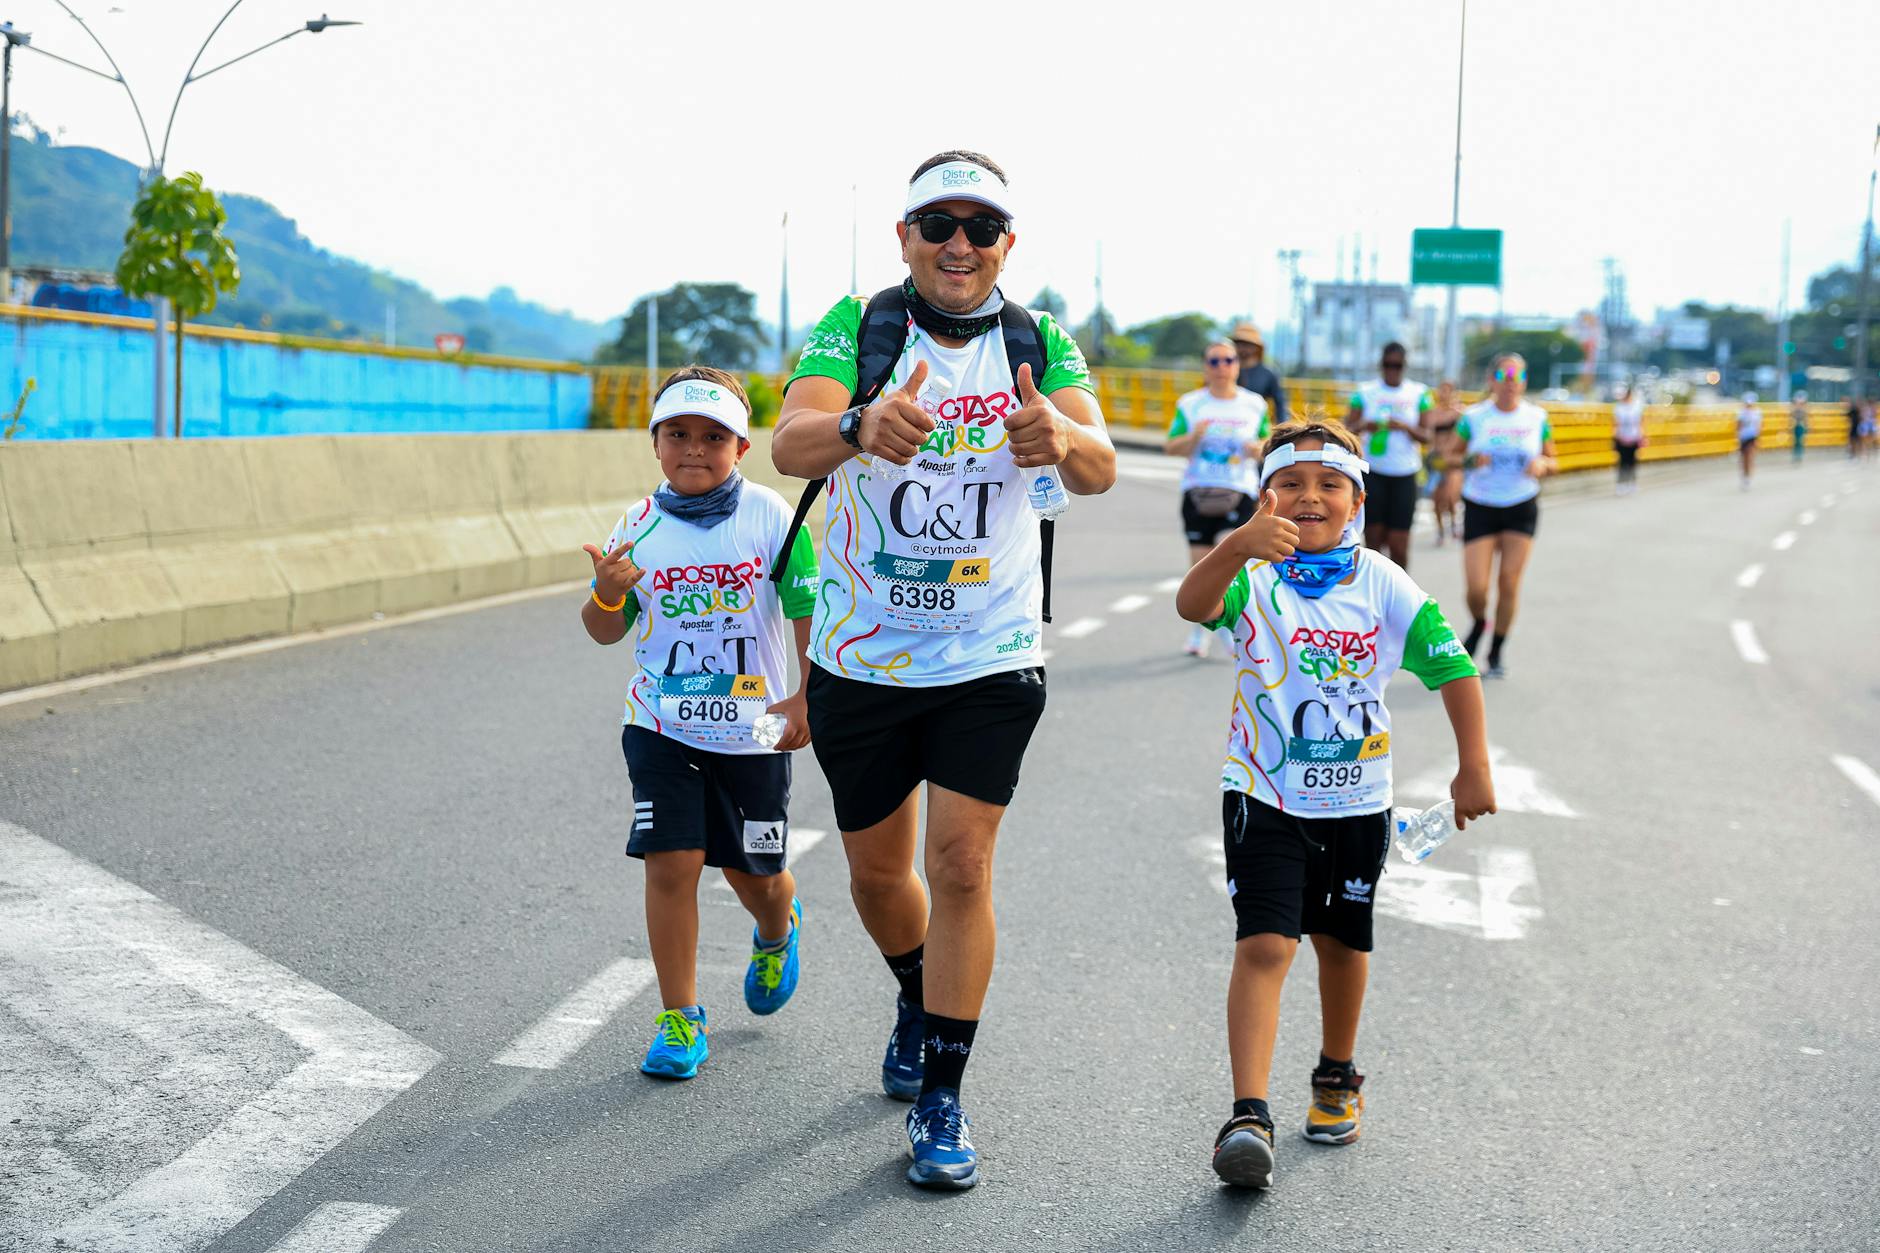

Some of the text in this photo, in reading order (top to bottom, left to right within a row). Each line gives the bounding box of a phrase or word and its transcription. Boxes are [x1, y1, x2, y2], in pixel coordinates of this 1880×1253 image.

[889, 479, 1003, 541] C&T
[910, 543, 978, 556] @cytmoda
[961, 565, 980, 576] 6K
[678, 584, 709, 593] PARA
[889, 584, 956, 611] 6398
[996, 641, 1020, 654] 2025
[742, 681, 758, 691] 6K
[678, 700, 739, 722] 6408
[1368, 740, 1382, 751] 6K
[1303, 765, 1362, 788] 6399
